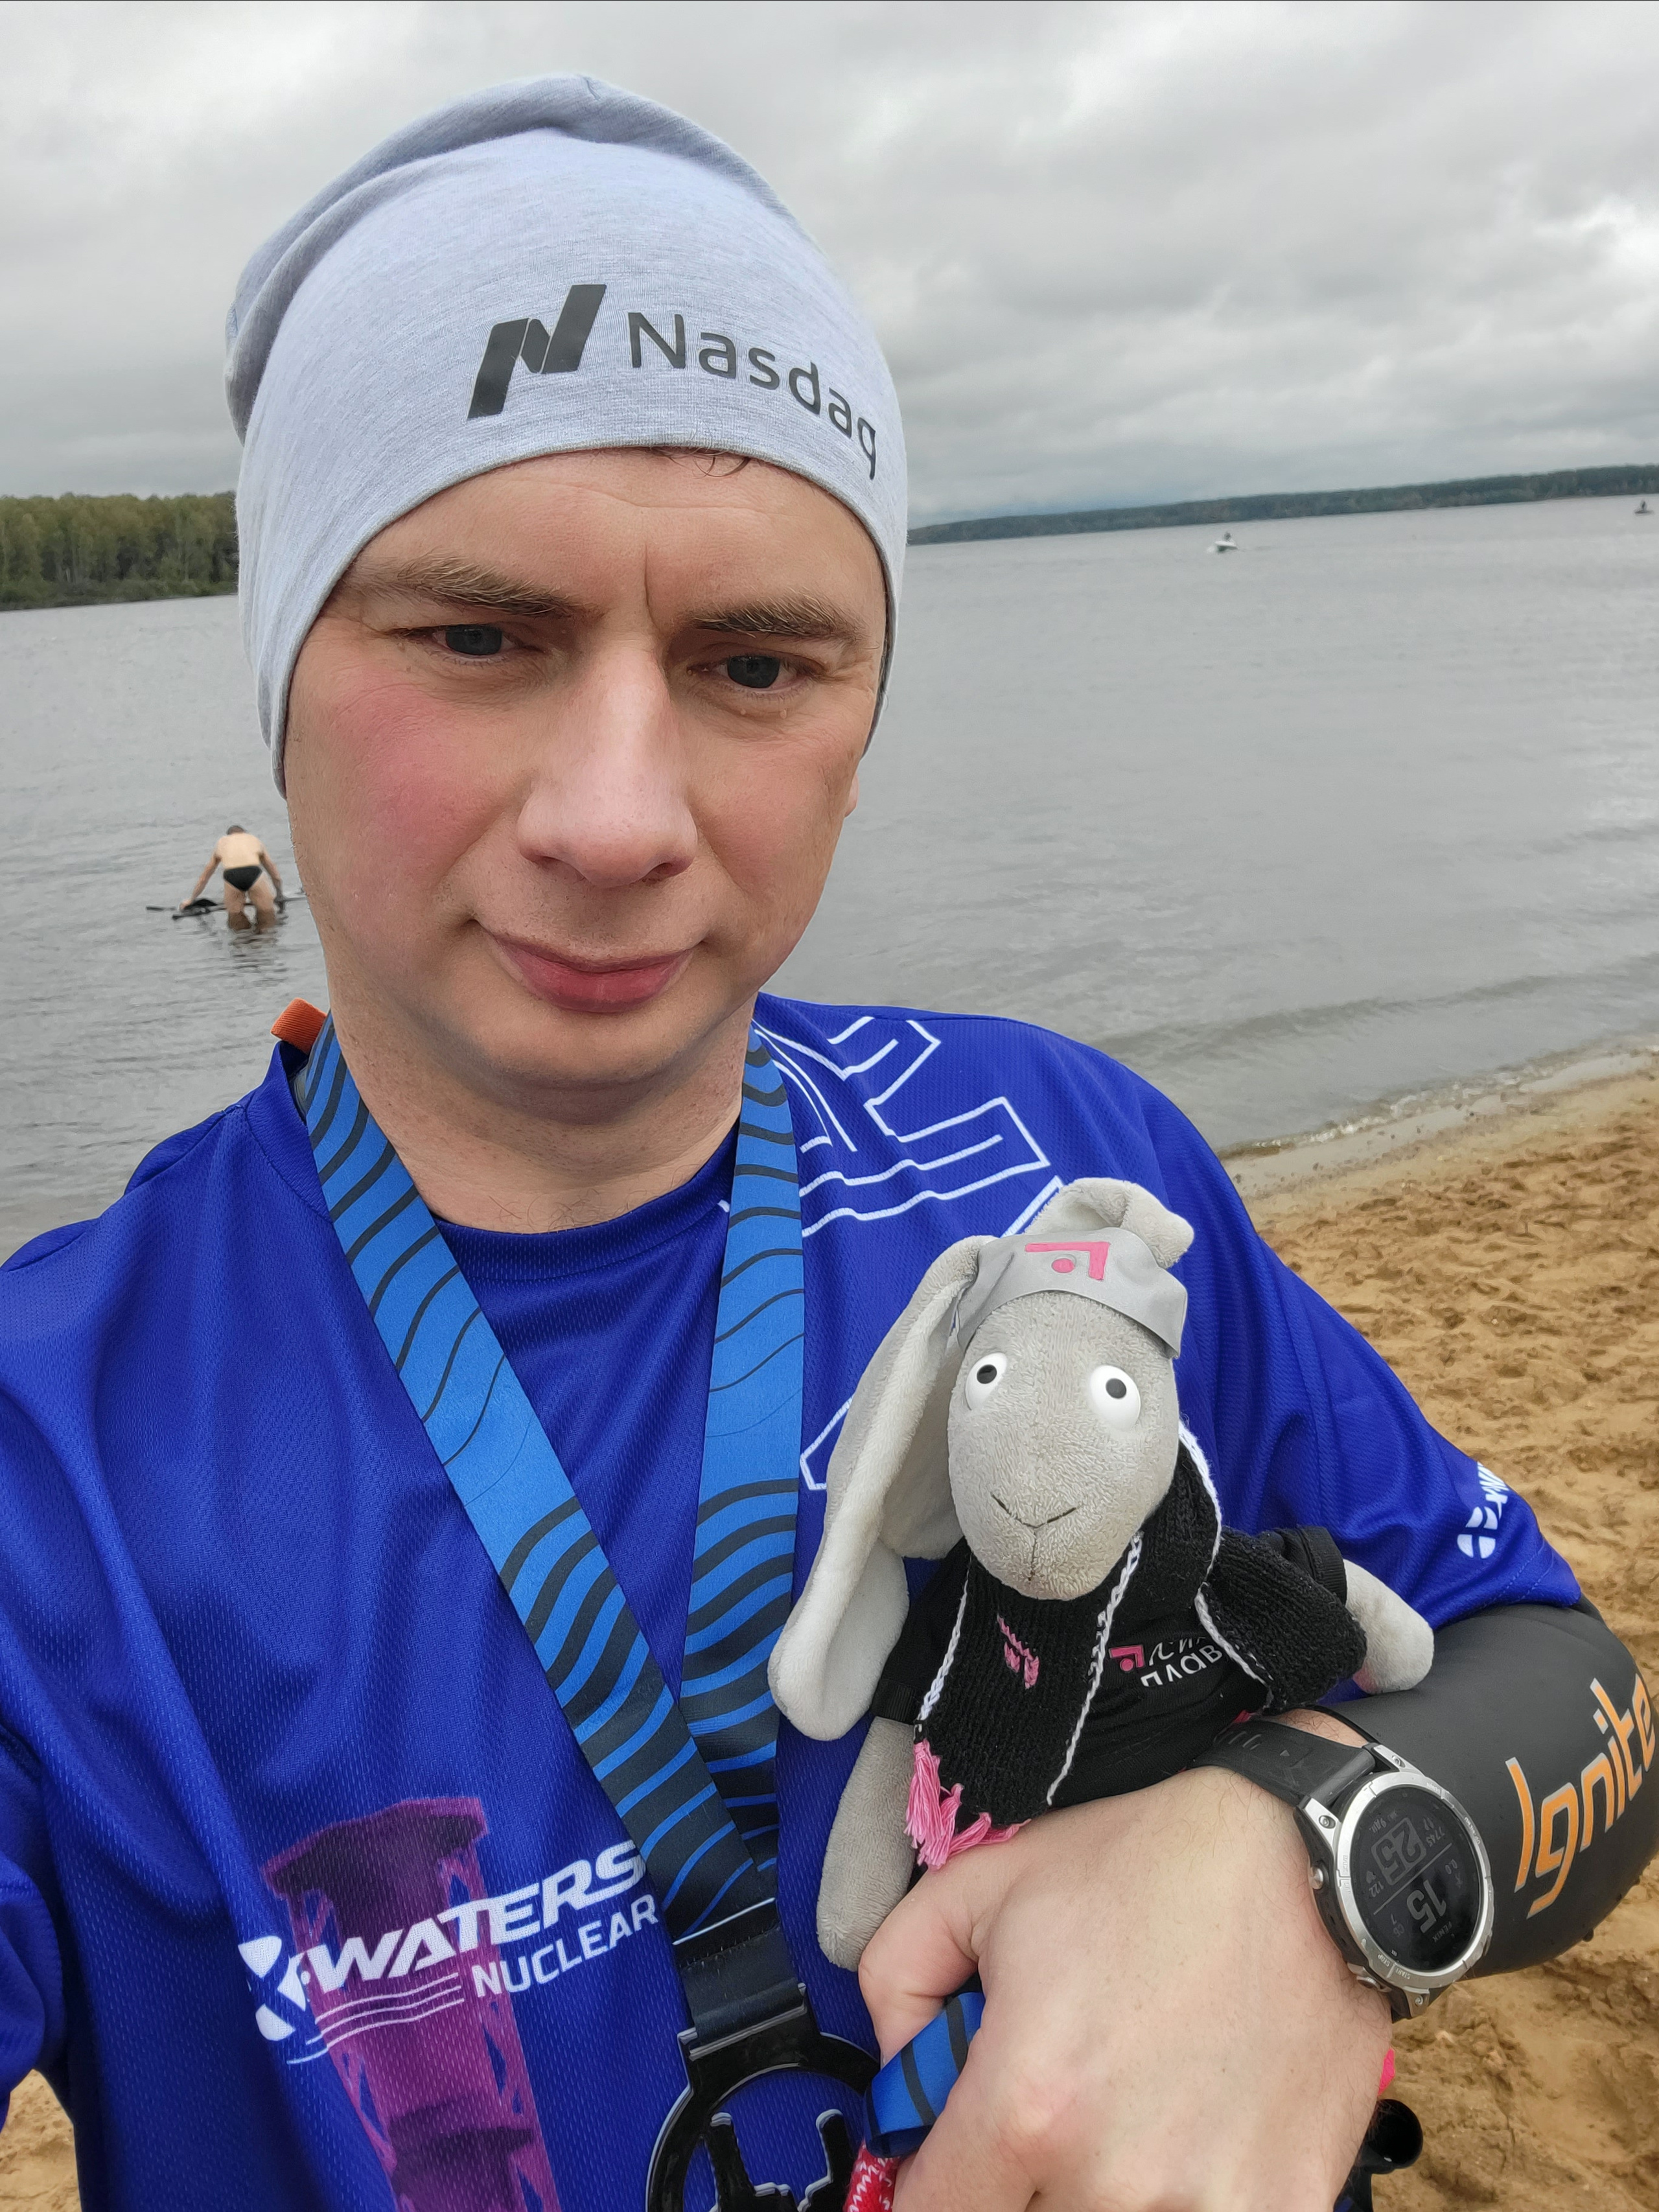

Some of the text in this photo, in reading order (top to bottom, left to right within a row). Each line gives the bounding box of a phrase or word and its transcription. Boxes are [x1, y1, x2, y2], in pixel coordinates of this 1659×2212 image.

[627, 312, 876, 480] Nasdaq
[1505, 1673, 1656, 1918] Ignite
[1376, 1822, 1421, 1880] 25
[1369, 1881, 1384, 1898] 122
[1407, 1880, 1446, 1933] 15
[472, 1894, 658, 1998] NUCLEAR
[1377, 1953, 1391, 1968] STOP
